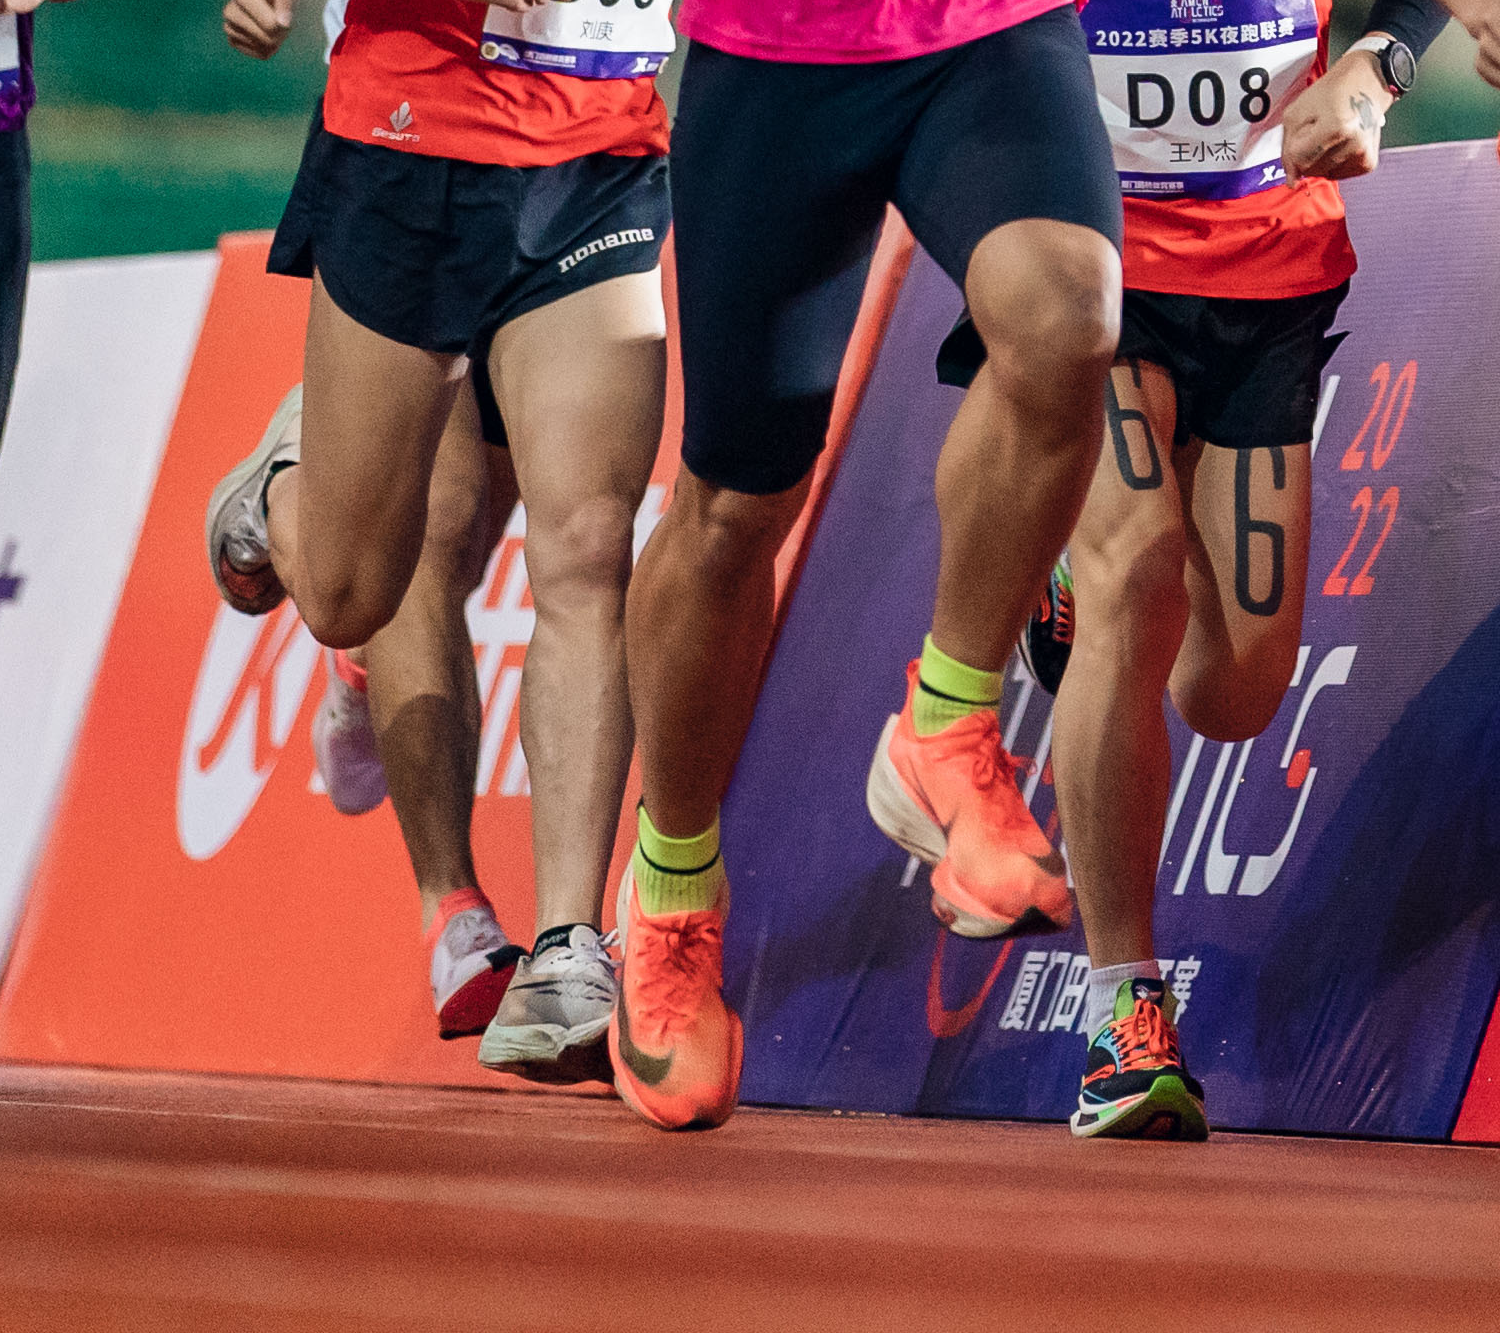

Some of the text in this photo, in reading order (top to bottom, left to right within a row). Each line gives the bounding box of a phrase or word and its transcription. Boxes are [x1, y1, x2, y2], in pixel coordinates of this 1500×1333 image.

[1096, 18, 1295, 48] 2022赛季5K夜跑联赛
[1126, 67, 1272, 129] D08
[1169, 140, 1237, 163] 王小杰
[557, 228, 655, 274] noname
[1340, 359, 1418, 471] 20
[1233, 446, 1287, 617] 6
[1322, 485, 1400, 596] 22
